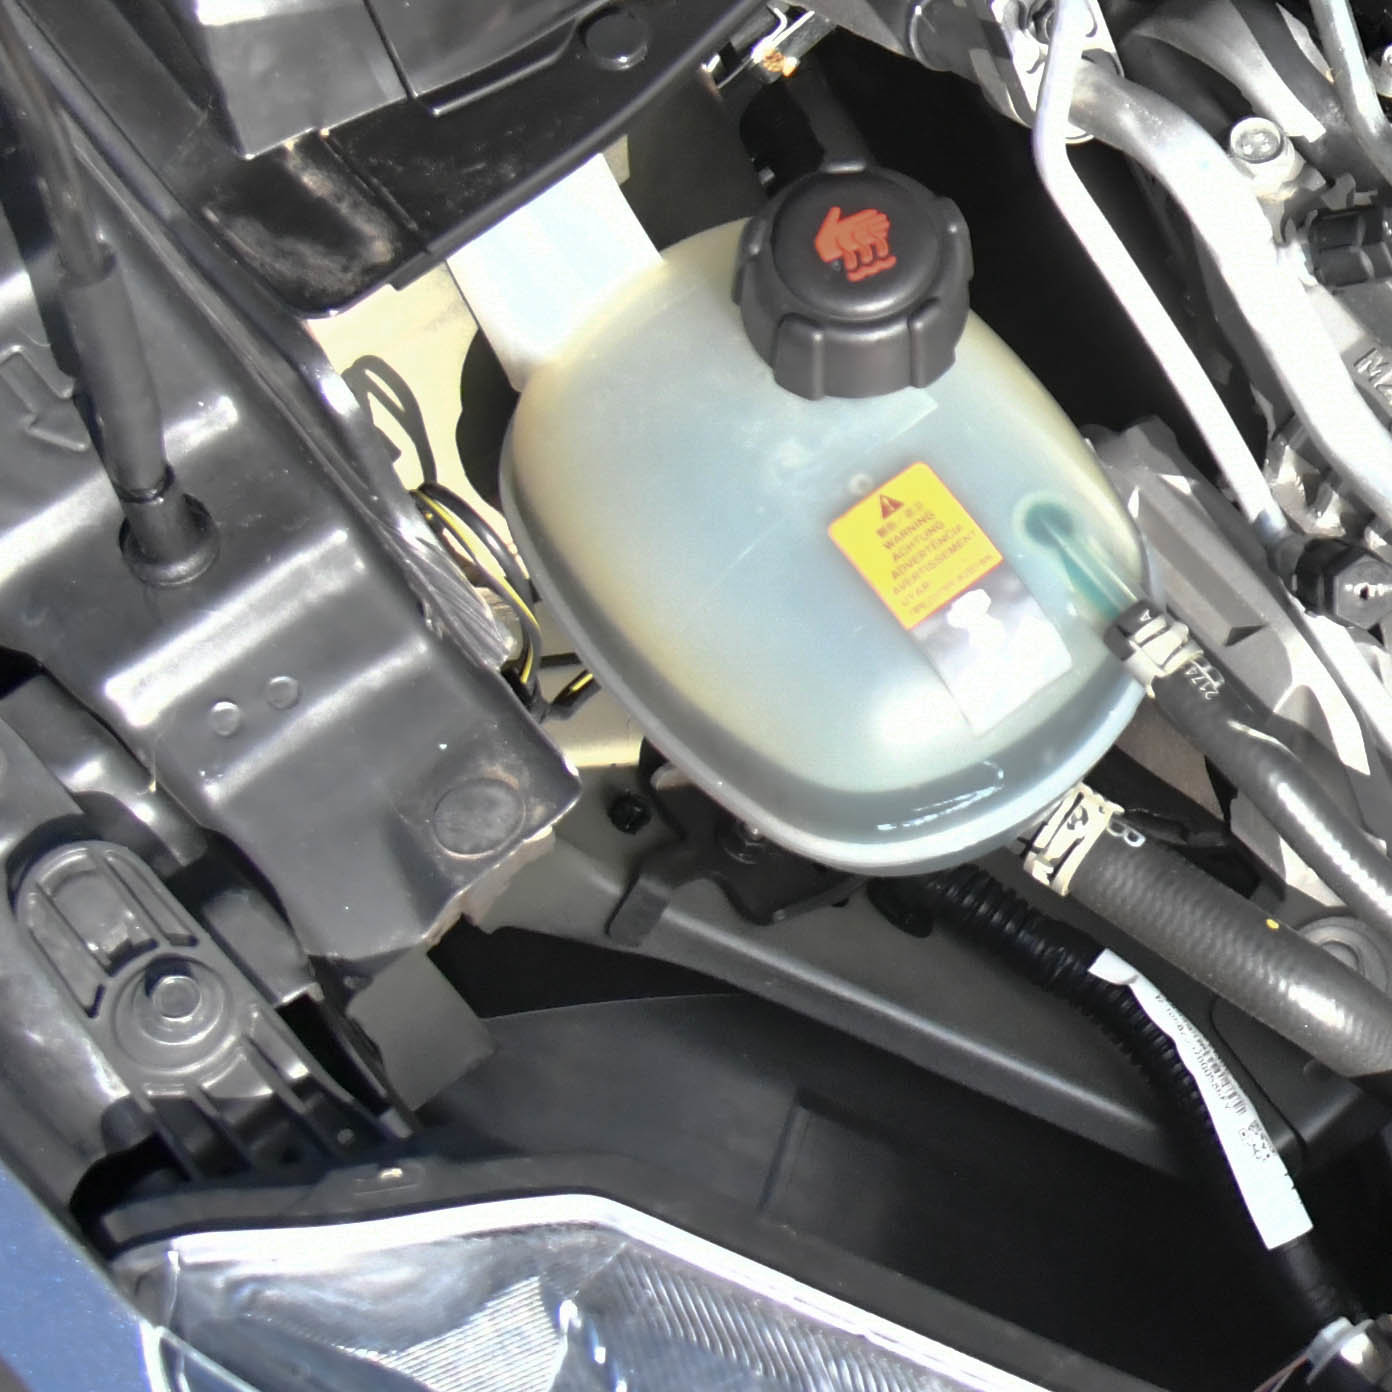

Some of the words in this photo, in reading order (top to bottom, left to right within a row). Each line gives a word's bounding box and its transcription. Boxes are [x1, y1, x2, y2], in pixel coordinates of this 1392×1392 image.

[883, 511, 937, 550] WARNING
[892, 520, 945, 562] ACHTUNG
[893, 530, 978, 596] AVERTISSEMENT
